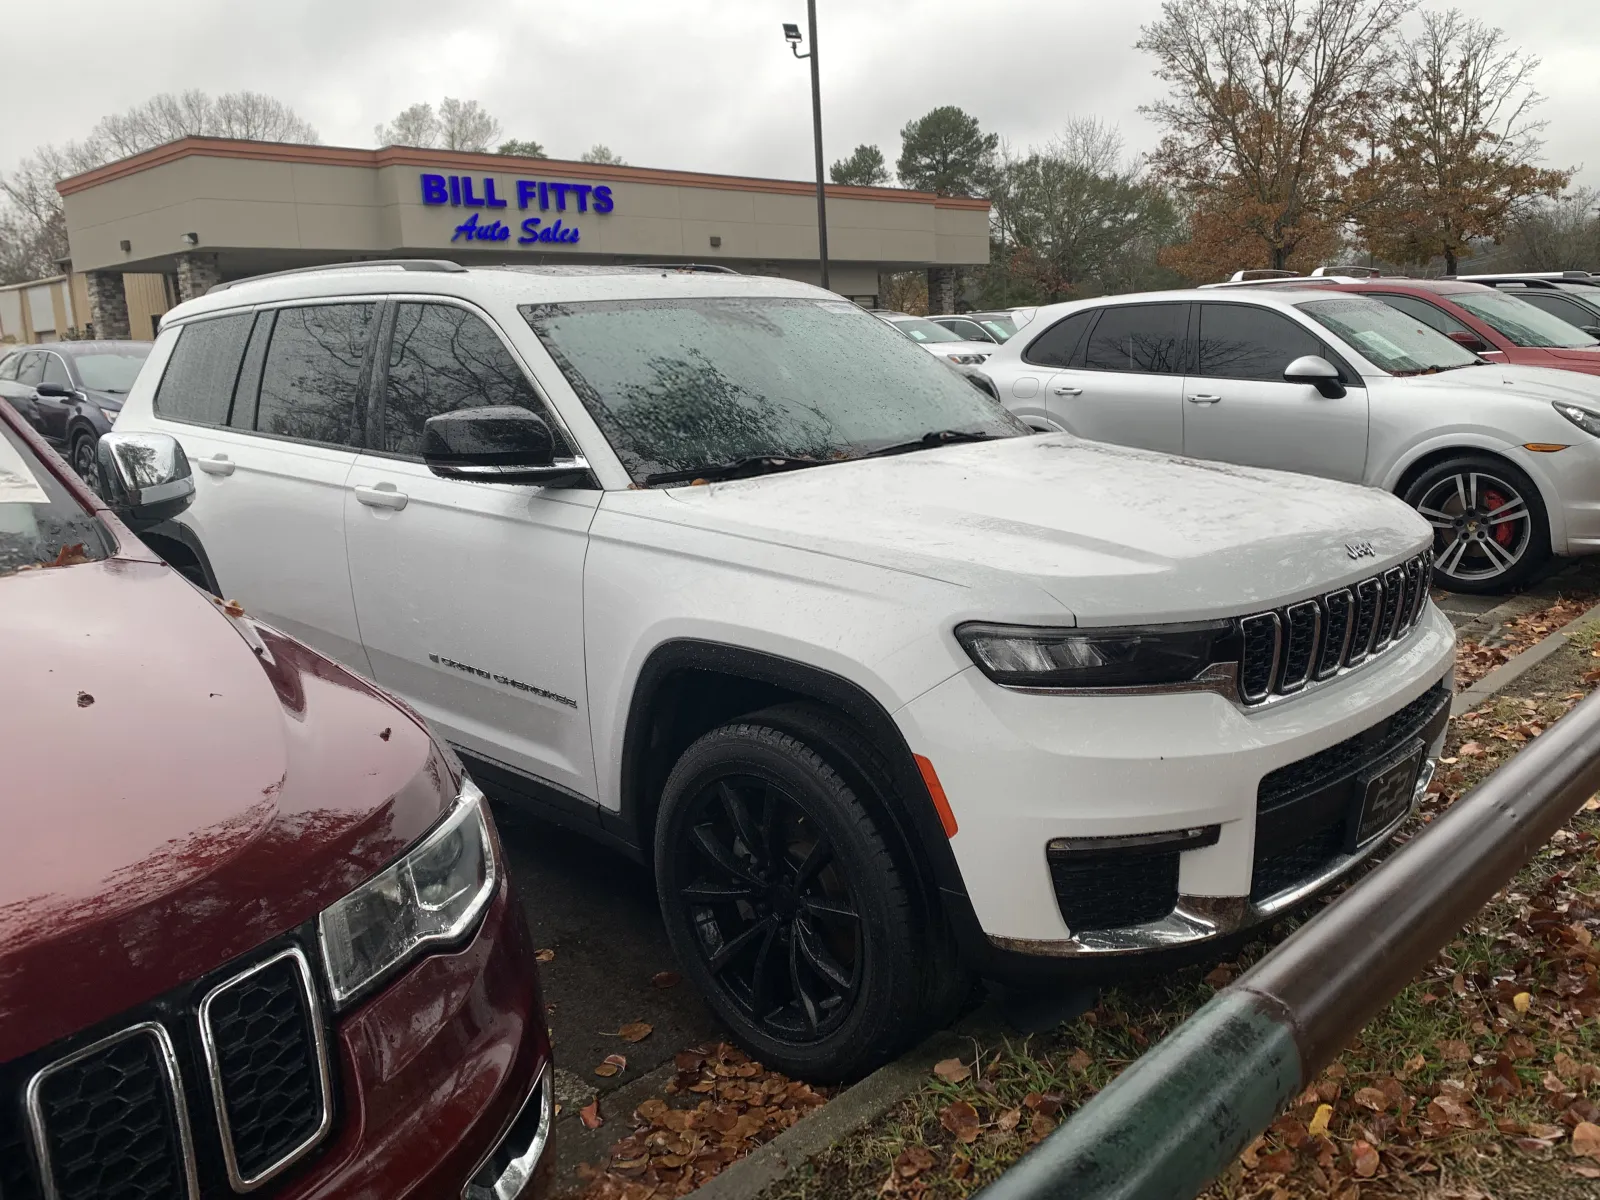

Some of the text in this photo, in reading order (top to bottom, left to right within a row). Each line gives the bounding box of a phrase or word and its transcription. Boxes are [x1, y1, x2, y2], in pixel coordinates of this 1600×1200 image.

[420, 173, 614, 213] BILL FITTS
[451, 212, 580, 244] Auto Sales
[1345, 540, 1376, 560] Jeep
